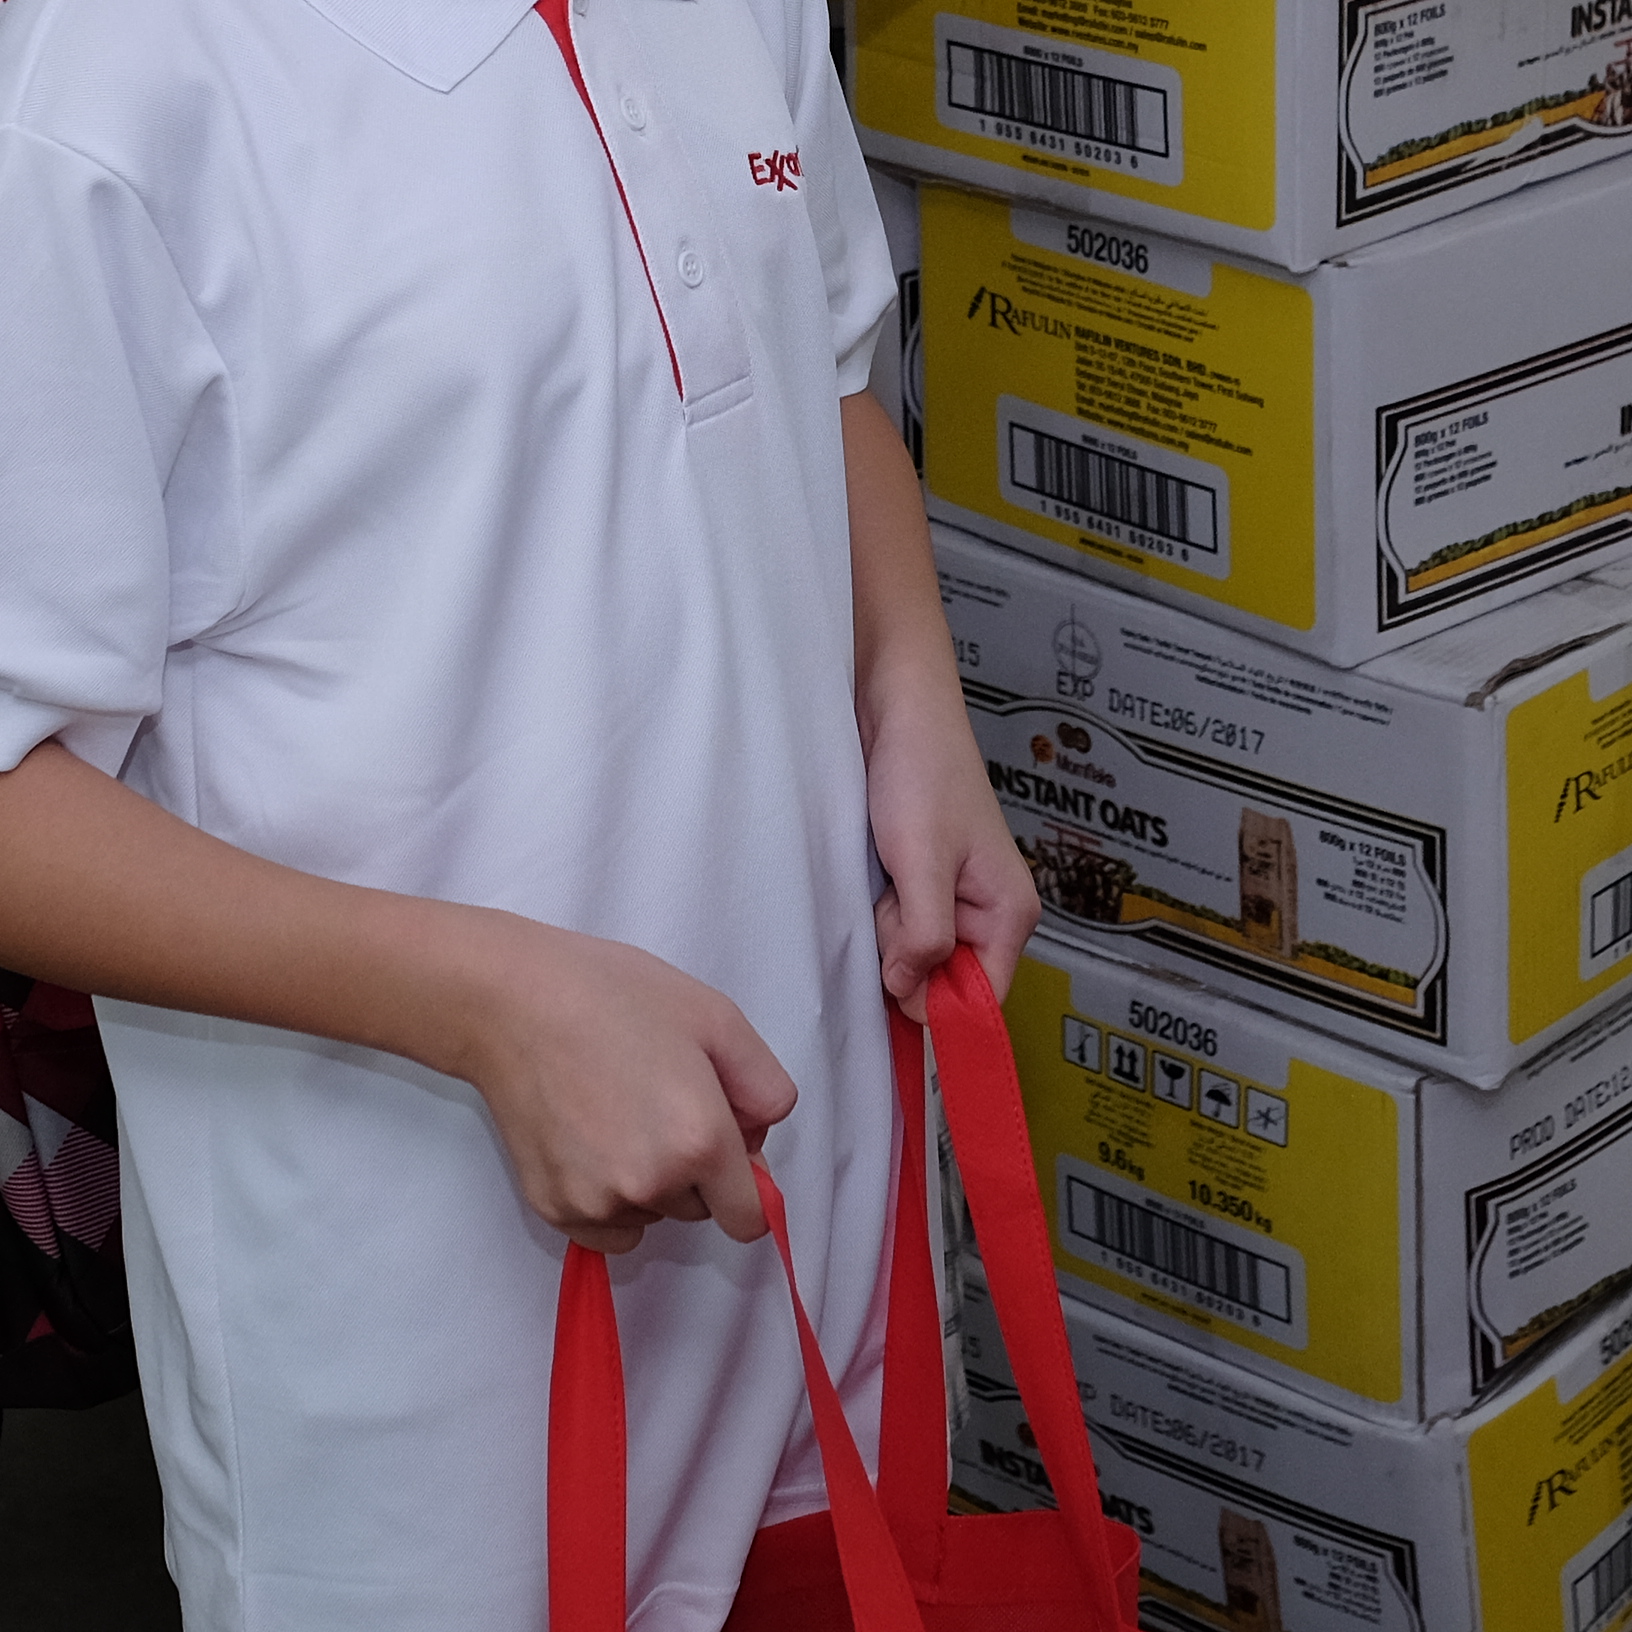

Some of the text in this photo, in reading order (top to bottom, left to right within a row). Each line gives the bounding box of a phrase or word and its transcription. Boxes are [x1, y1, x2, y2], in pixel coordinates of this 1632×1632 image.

[747, 149, 801, 192] Exxo
[1067, 224, 1149, 274] 502036
[987, 289, 1072, 342] RAFULIN
[1056, 670, 1095, 702] EXP
[1108, 687, 1266, 756] DATE:06/2017
[1098, 798, 1169, 848] OATS
[1127, 1000, 1218, 1057] 502036
[979, 1439, 1155, 1535] INSTA ATS
